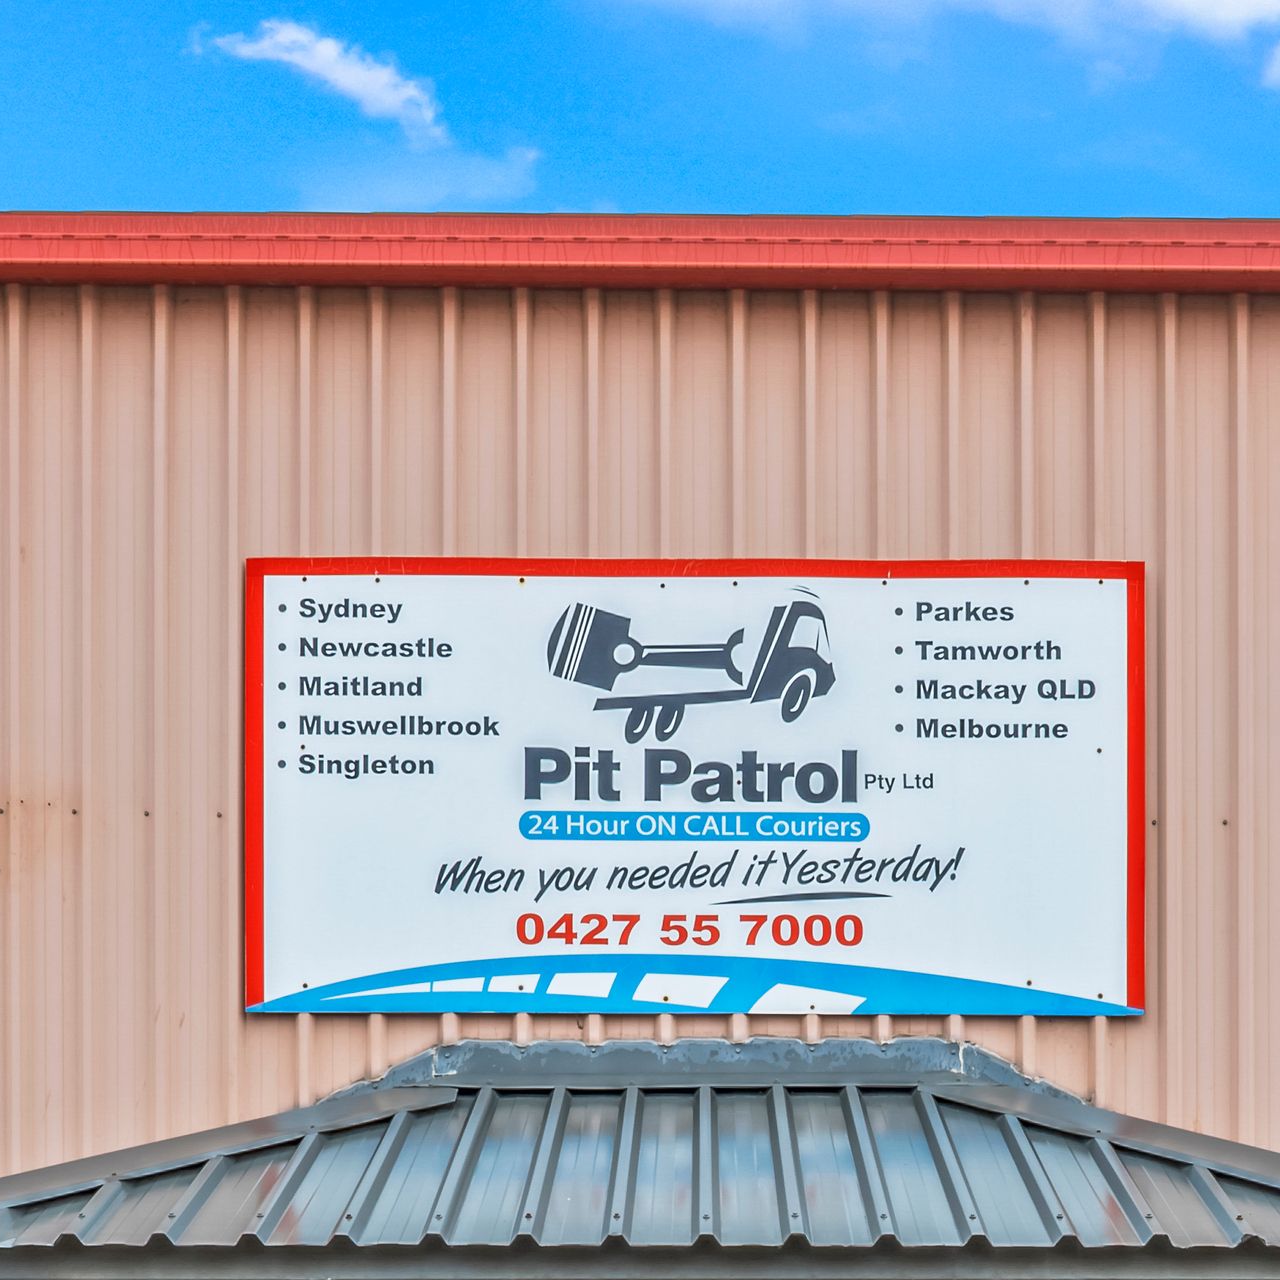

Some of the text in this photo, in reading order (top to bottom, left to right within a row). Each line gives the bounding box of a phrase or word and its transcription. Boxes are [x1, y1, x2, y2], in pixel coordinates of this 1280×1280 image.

[298, 598, 403, 624] Sydney
[916, 601, 1015, 622] Parkes
[298, 637, 453, 658] Newcastle
[915, 640, 1062, 661] Tamworth
[298, 676, 423, 697] Maitland
[916, 679, 1096, 705] Mackay QLD
[298, 715, 500, 736] Muswellbrook
[916, 718, 1069, 739] Melbourne
[298, 753, 435, 780] Singleton
[523, 746, 934, 804] Pit Patrol Pty Ltd
[527, 815, 862, 837] 24 Hour ON CALL Couriers
[434, 844, 966, 904] When you needed it Yesterday!
[515, 912, 865, 948] 0427 55 7000
